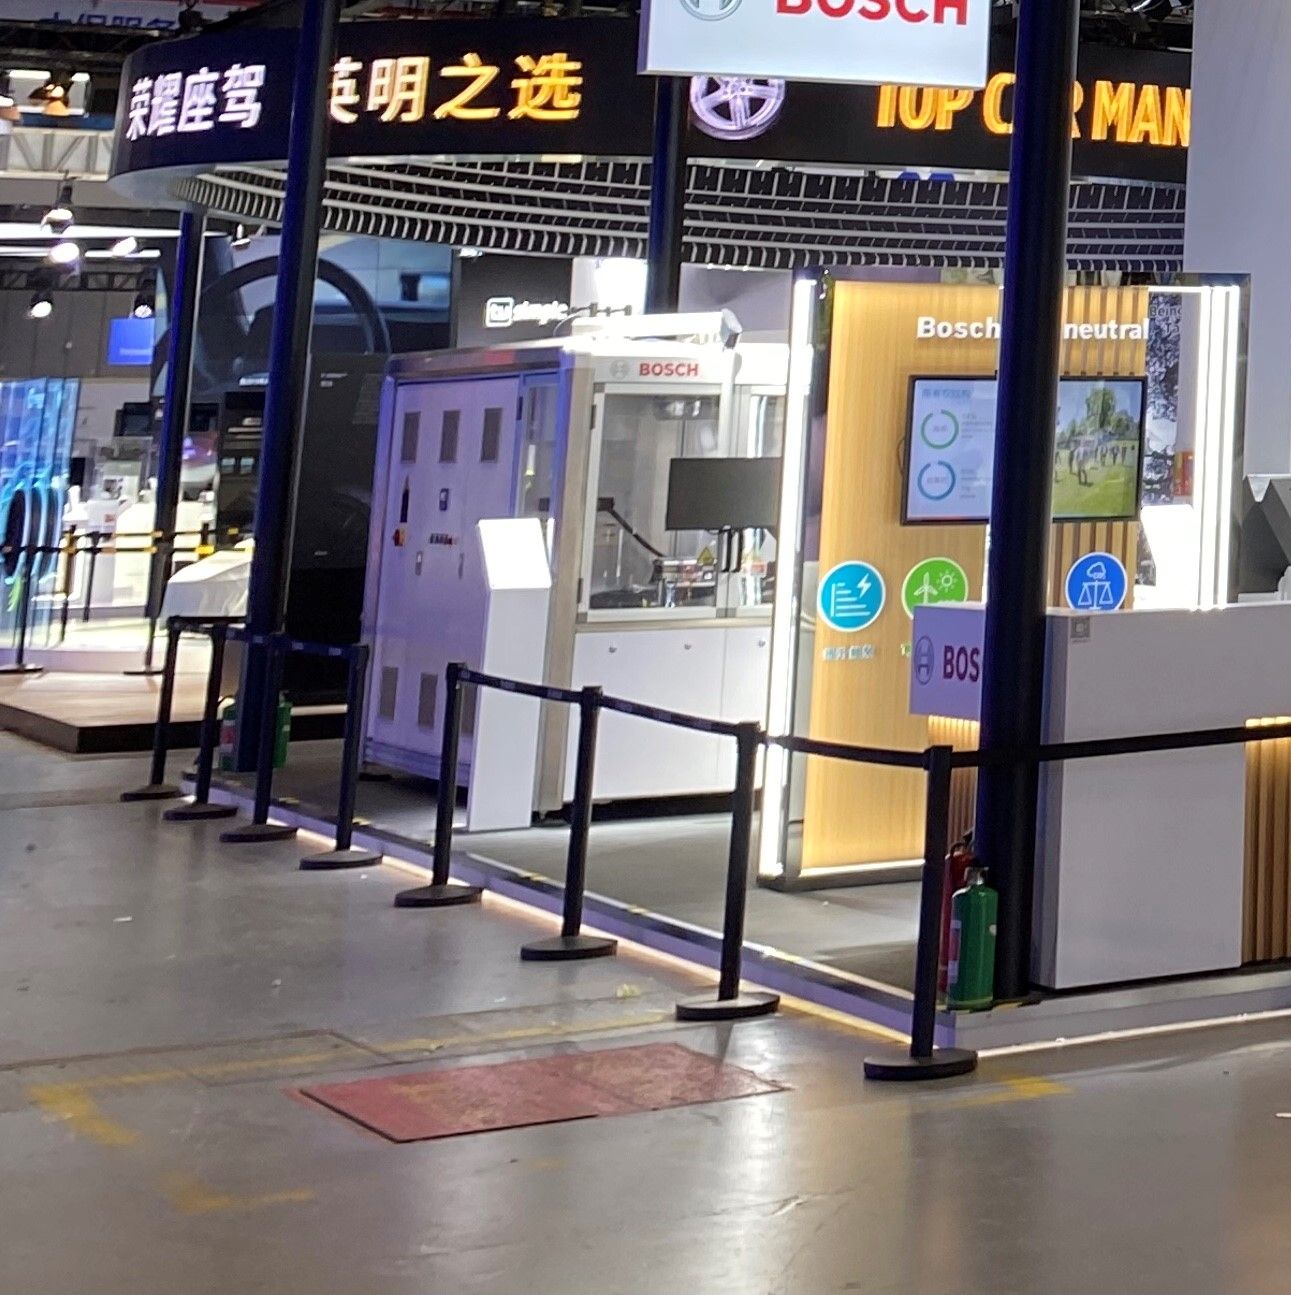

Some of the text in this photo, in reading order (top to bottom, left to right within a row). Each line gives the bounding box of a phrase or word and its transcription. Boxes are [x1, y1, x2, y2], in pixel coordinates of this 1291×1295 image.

[126, 62, 267, 142] 荣耀座驾
[916, 316, 1001, 339] Bosch
[1063, 318, 1150, 340] neutral
[638, 362, 699, 377] BOSCH
